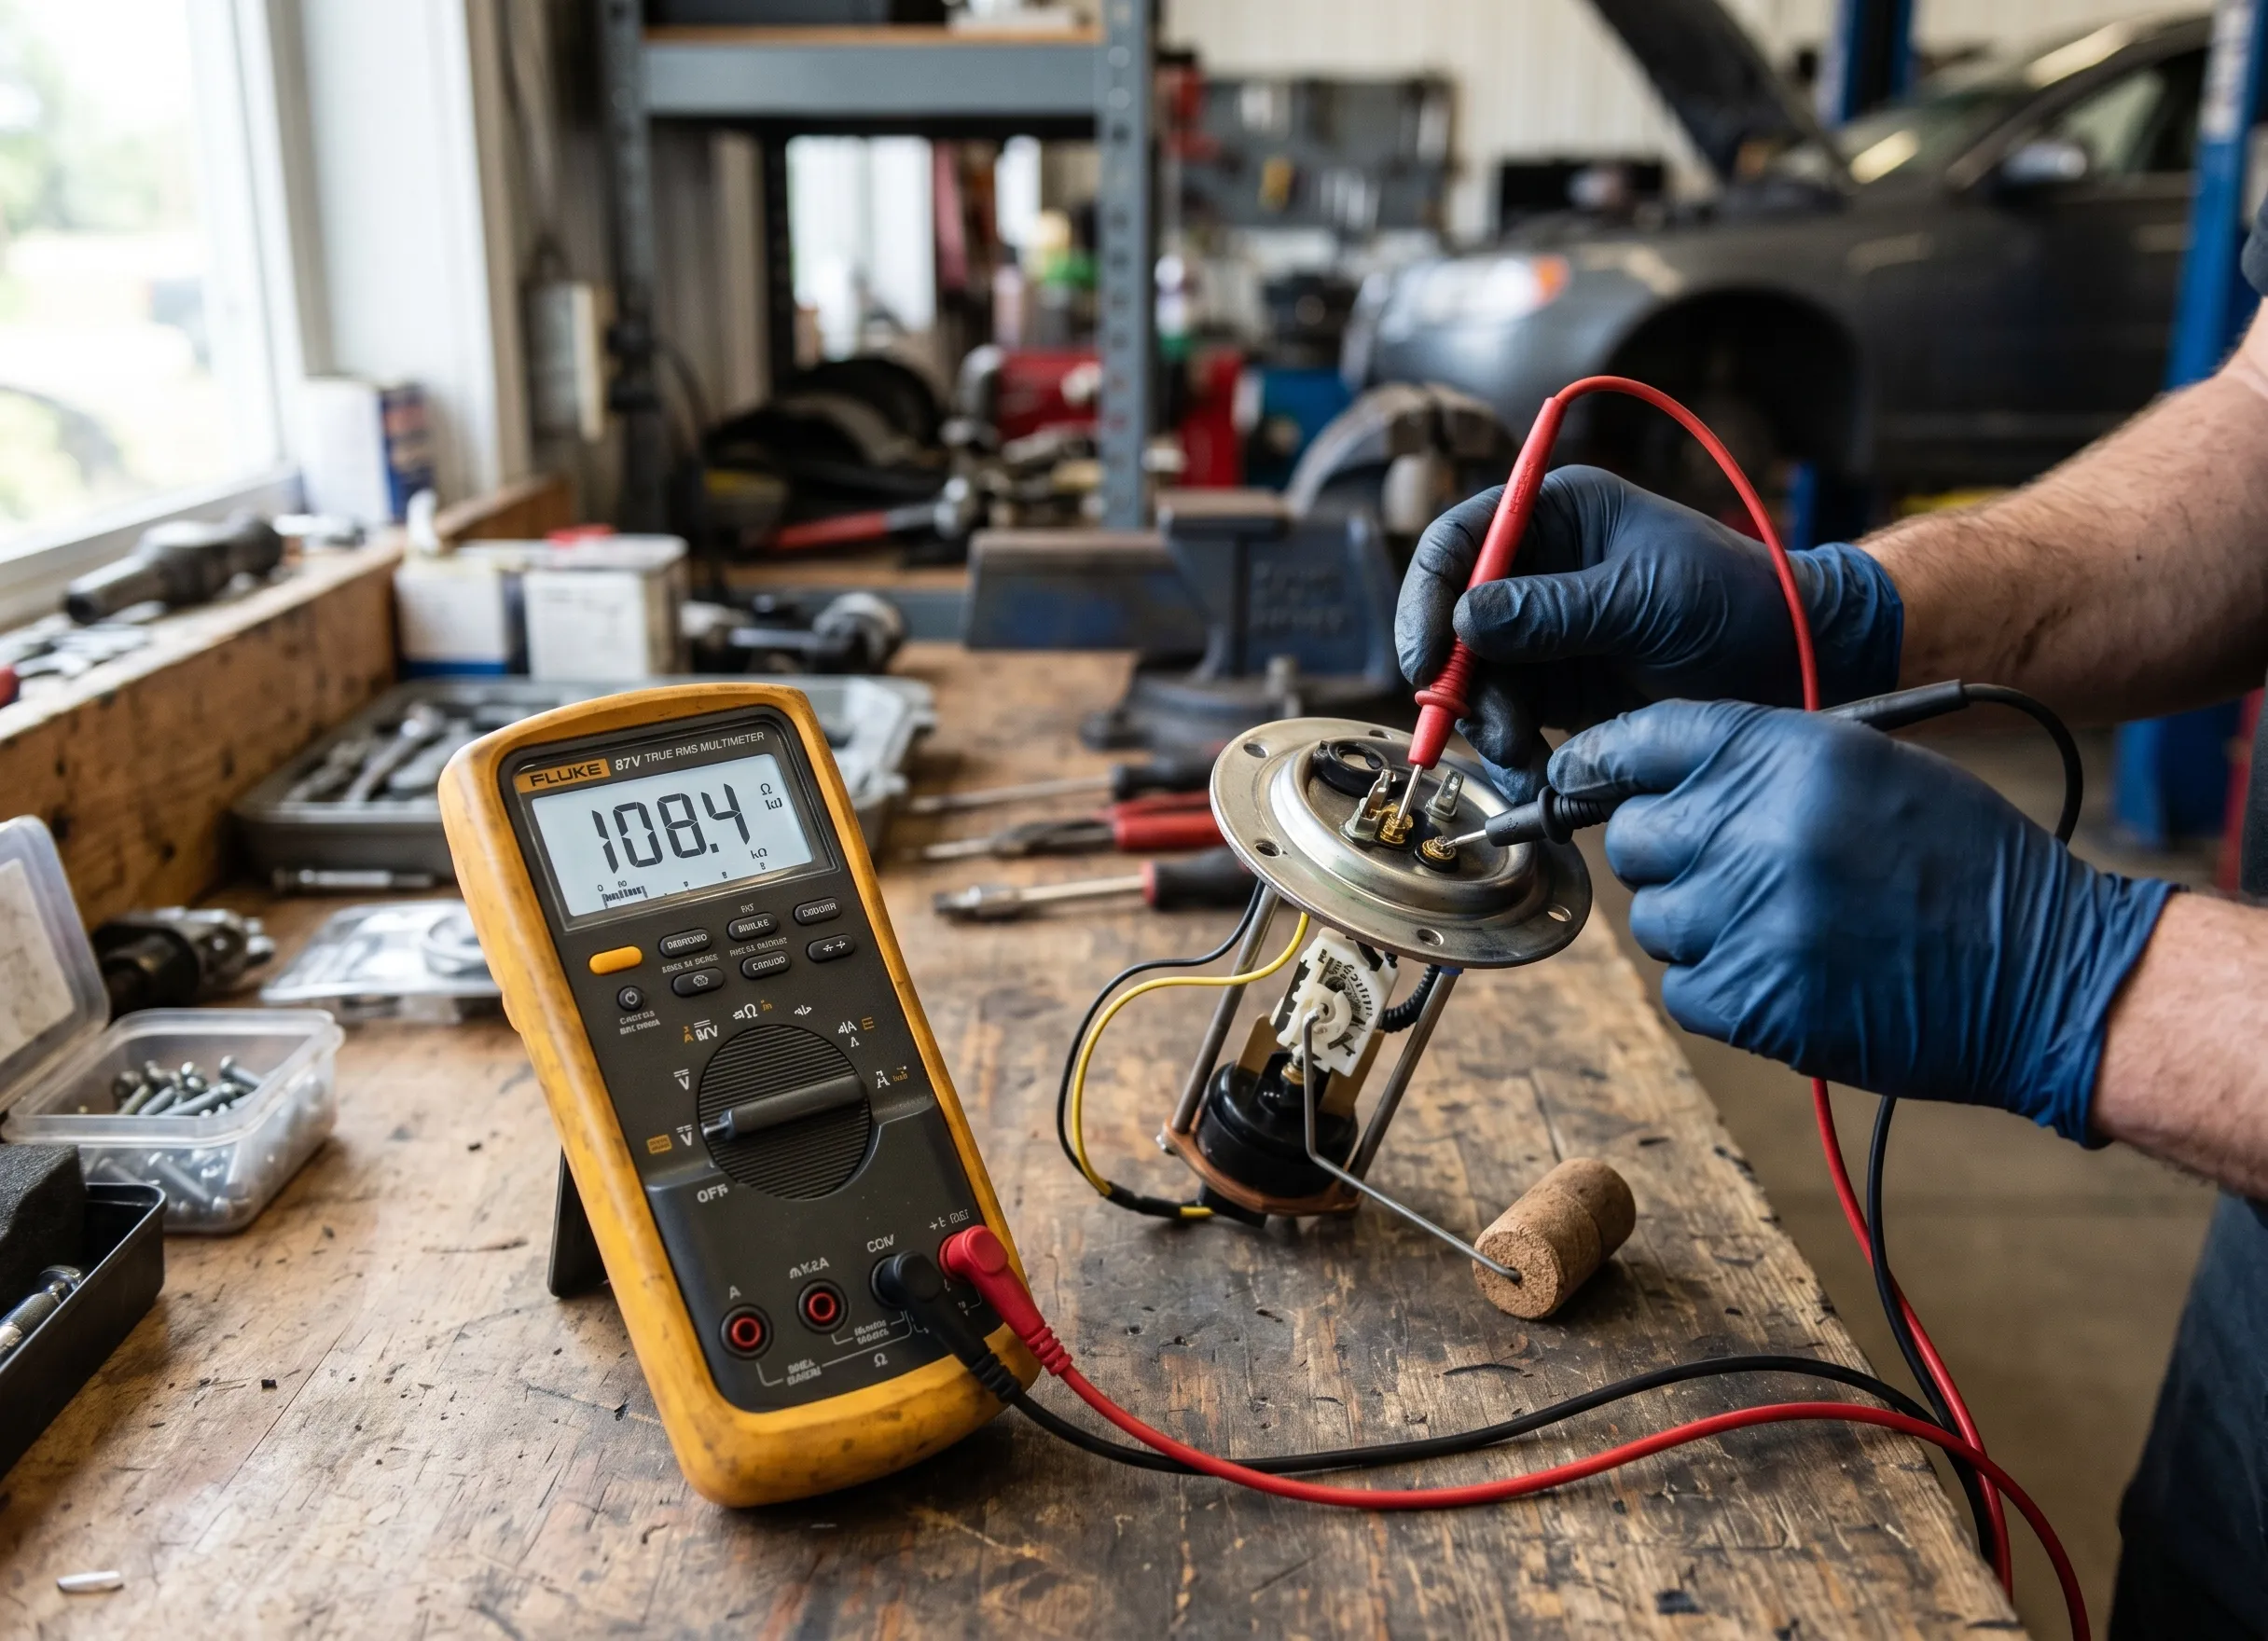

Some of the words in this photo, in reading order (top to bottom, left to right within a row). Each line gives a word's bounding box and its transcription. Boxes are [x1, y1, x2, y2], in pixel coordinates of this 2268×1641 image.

[615, 755, 642, 771] 87V
[644, 749, 673, 763] TRUE
[675, 744, 698, 757] RMS
[699, 731, 765, 752] MULTIMETER
[529, 762, 602, 787] FLUKE
[591, 783, 751, 874] 108.4
[728, 1285, 741, 1299] A
